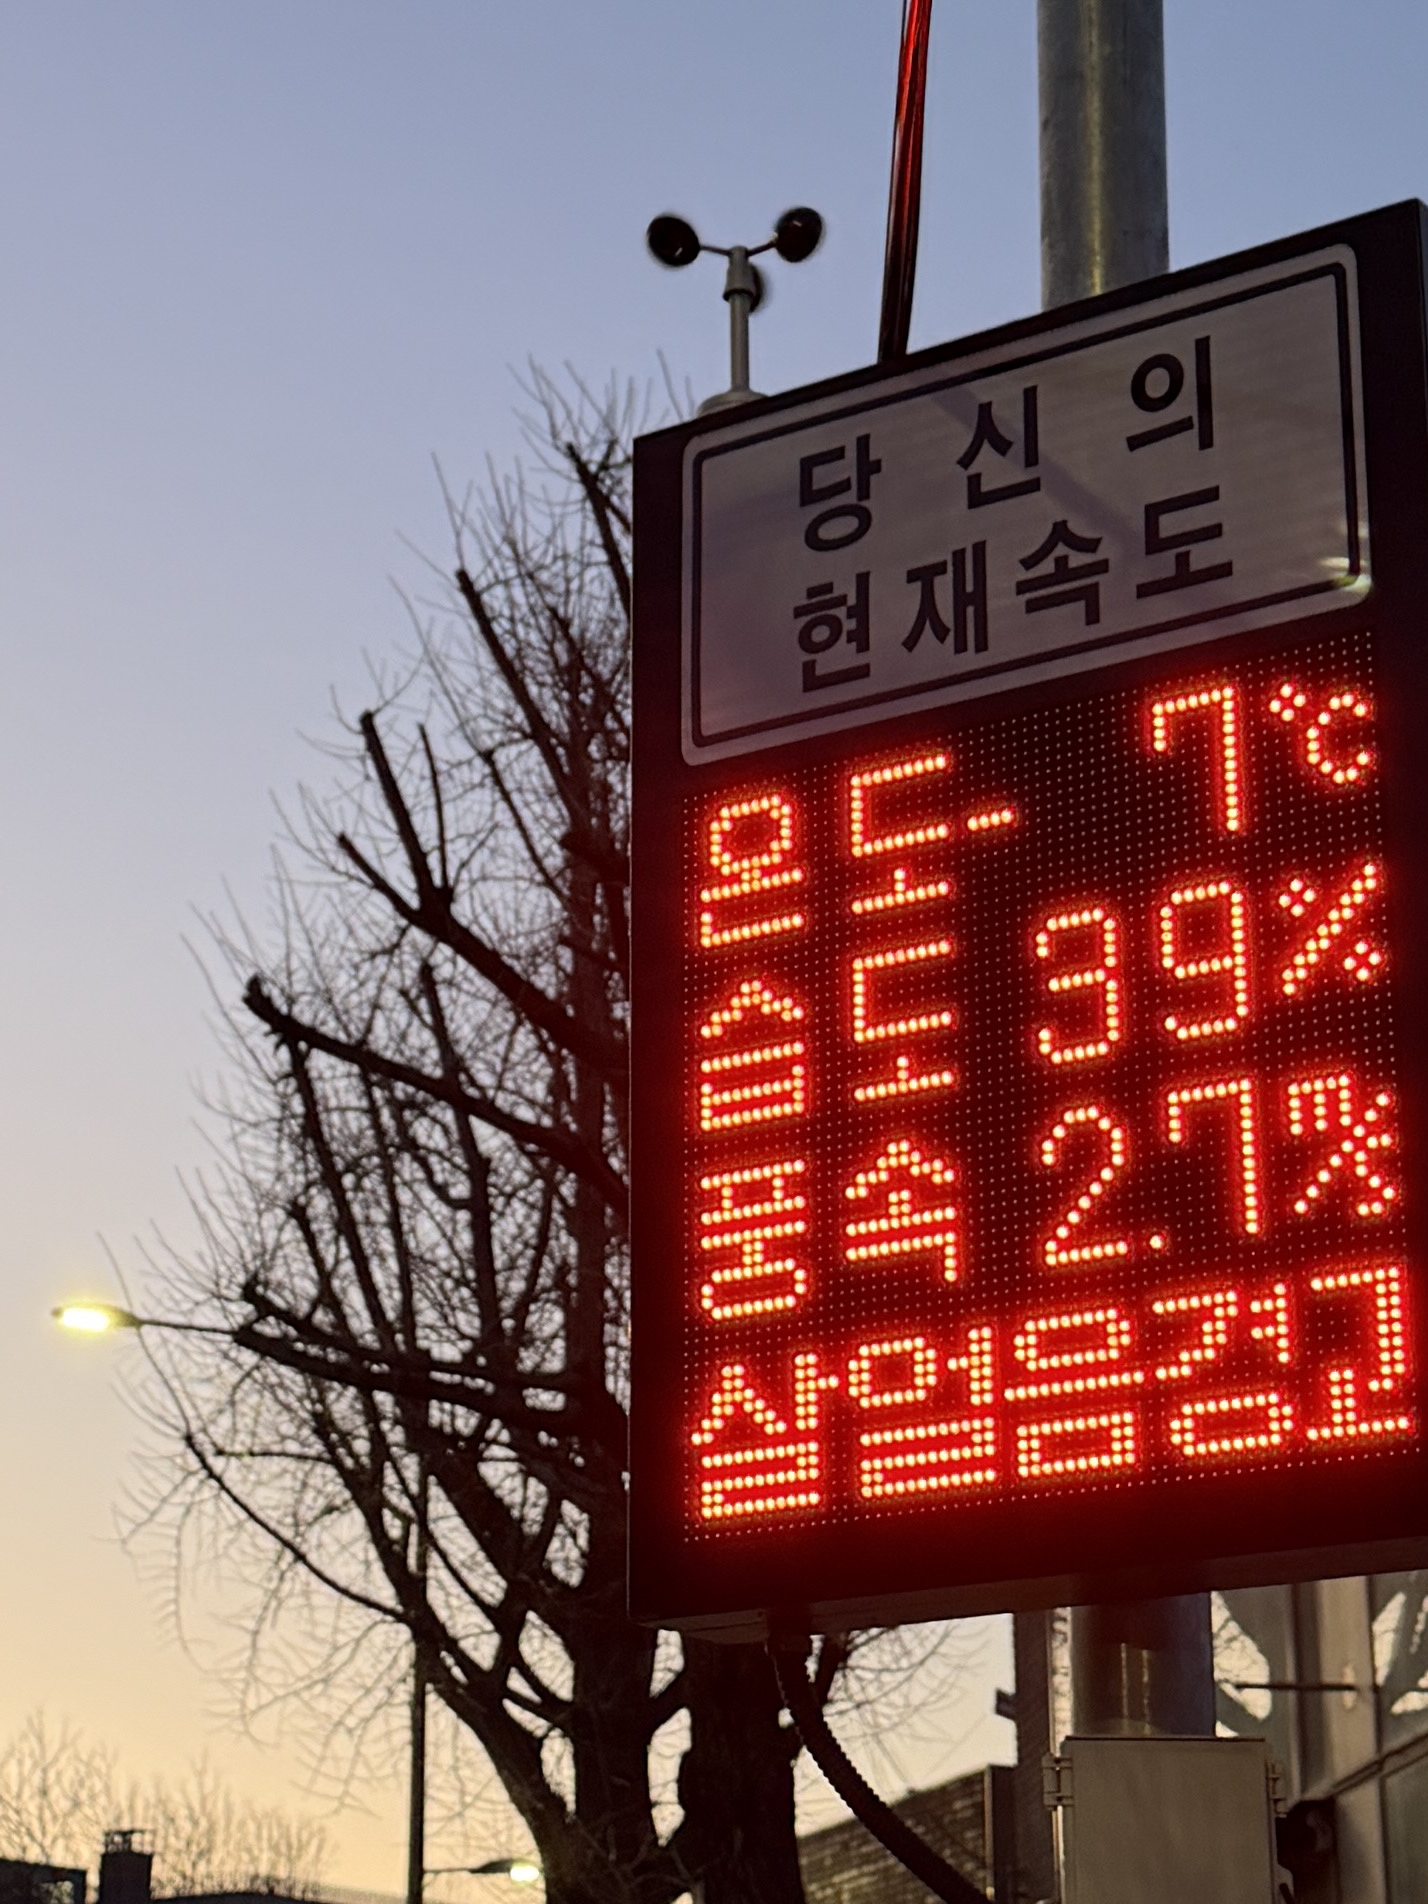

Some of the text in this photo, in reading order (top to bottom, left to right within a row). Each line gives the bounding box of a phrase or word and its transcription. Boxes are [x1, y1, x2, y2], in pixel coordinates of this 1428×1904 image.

[791, 484, 1236, 696] 현재속도
[697, 859, 1385, 1133] 습도 39%
[697, 1136, 960, 1323] 풍속
[687, 1263, 1413, 1521] 살얼음경고
